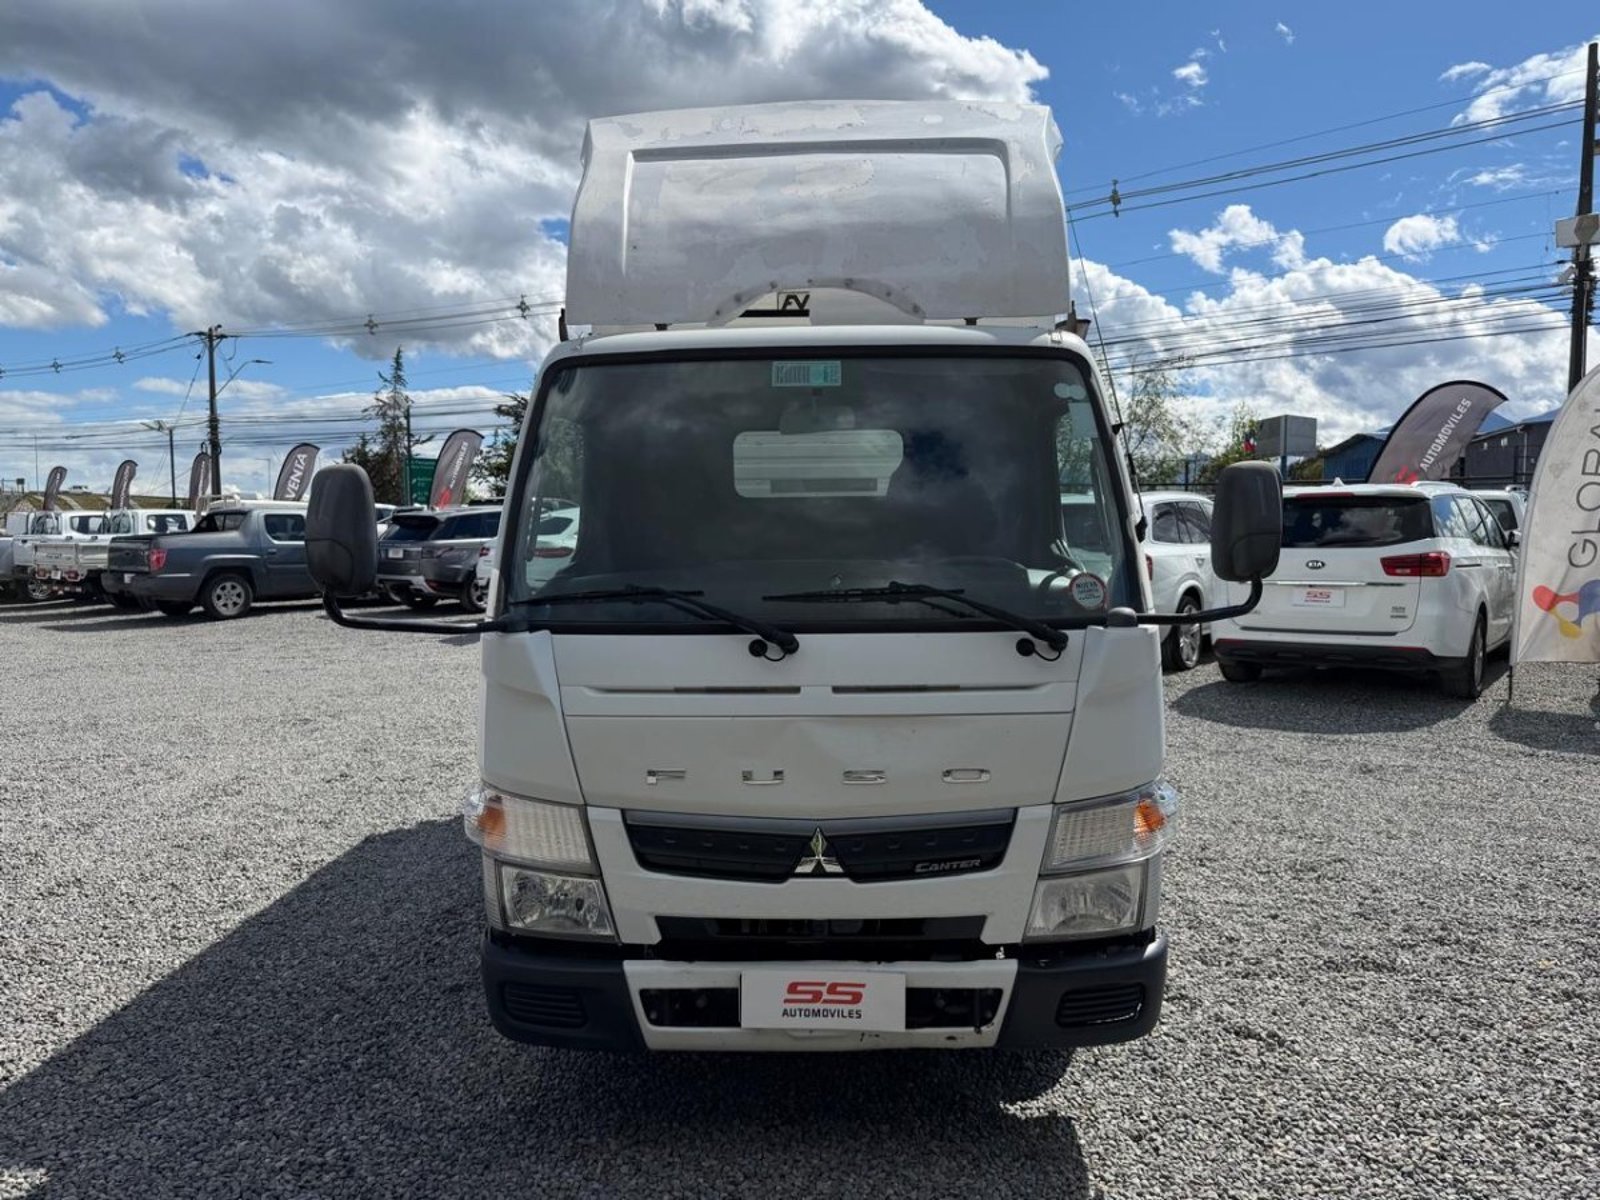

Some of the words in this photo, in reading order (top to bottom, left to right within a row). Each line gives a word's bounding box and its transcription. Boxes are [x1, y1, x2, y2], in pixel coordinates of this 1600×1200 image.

[1420, 398, 1472, 472] AUTOMOVILES
[285, 453, 308, 498] VENTA
[1567, 408, 1600, 569] GLOB
[646, 768, 991, 785] FUSO
[914, 859, 981, 873] CANTER
[783, 981, 867, 1005] SS
[782, 1008, 862, 1019] AUTOMOVILES
